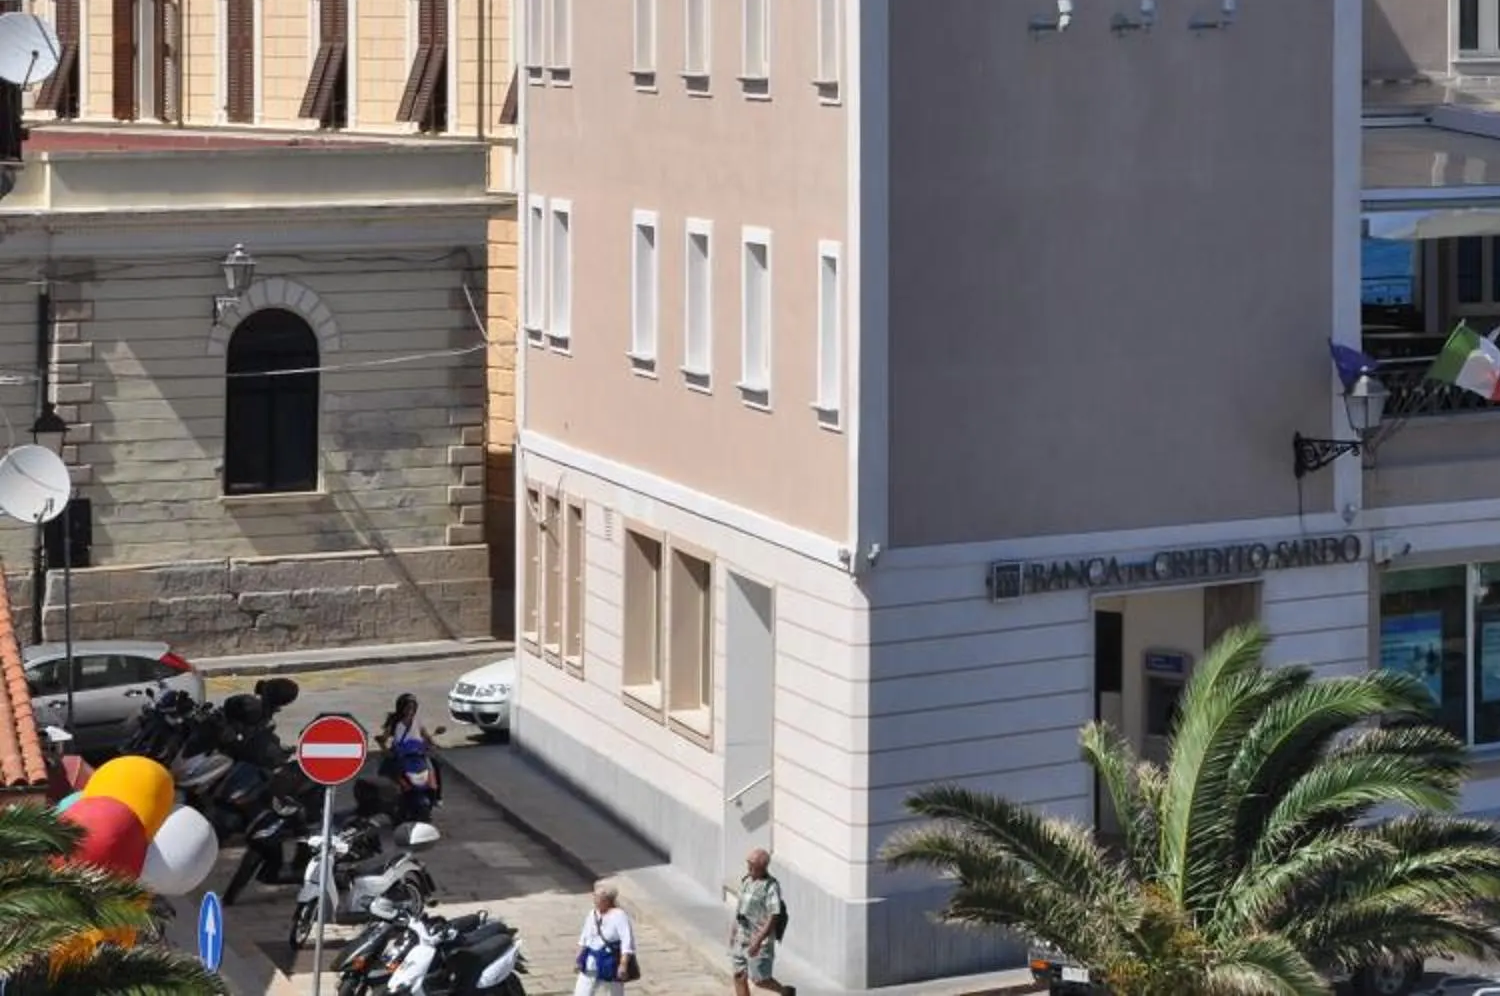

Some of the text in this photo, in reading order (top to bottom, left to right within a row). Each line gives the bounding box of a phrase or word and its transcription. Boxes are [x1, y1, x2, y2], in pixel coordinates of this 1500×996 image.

[1031, 556, 1122, 591] BANCA
[1153, 542, 1269, 581] CREDITO
[1275, 534, 1361, 570] SARDO
